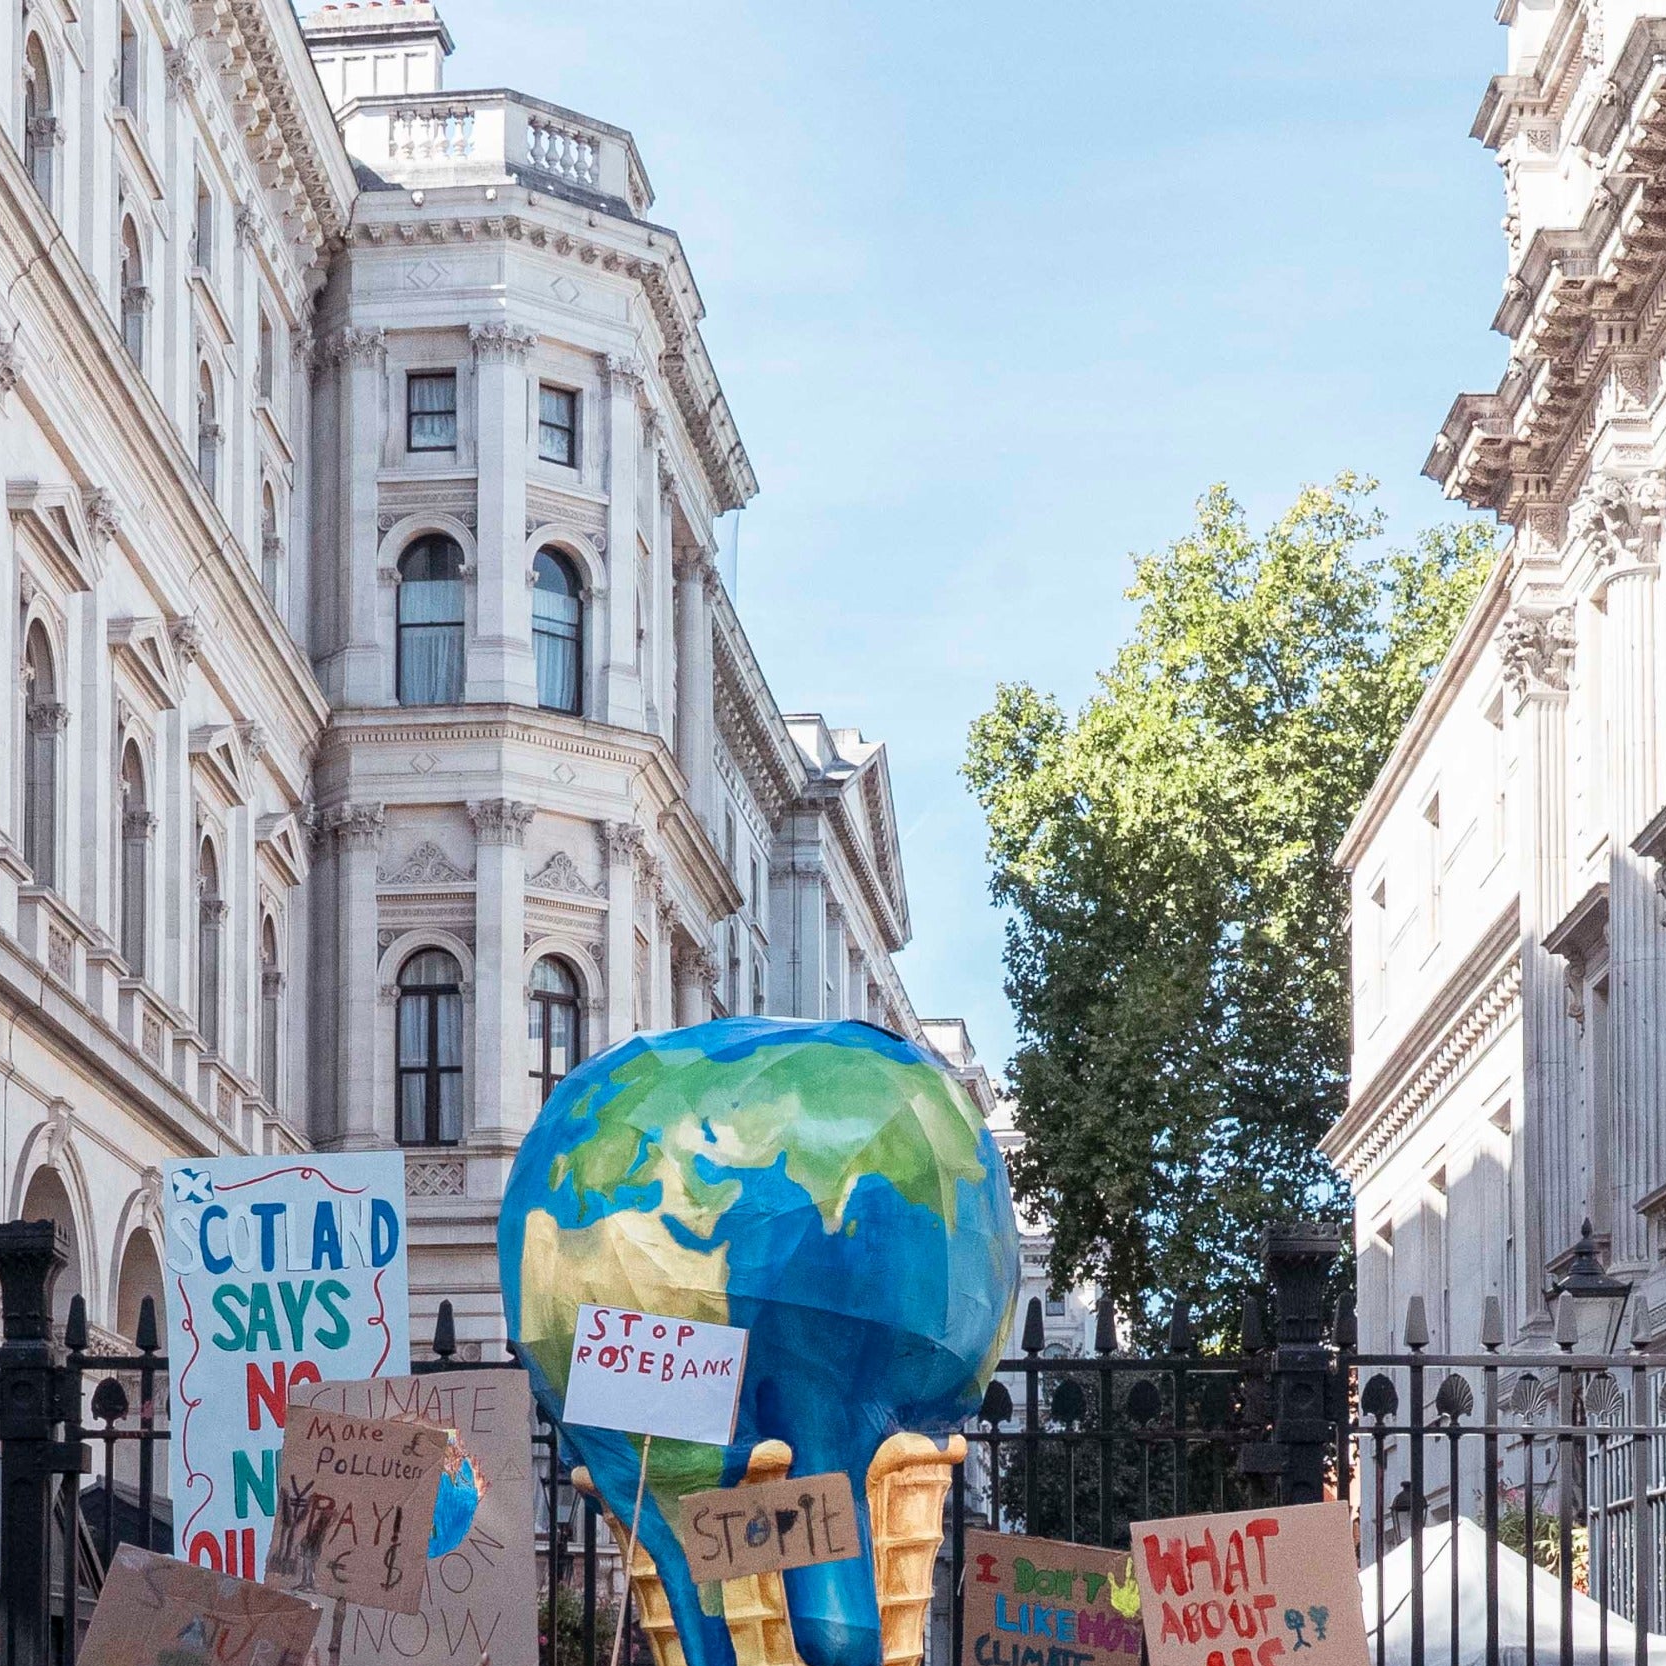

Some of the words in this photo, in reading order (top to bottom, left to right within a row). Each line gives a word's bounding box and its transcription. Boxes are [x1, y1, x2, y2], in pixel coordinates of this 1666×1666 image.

[165, 1196, 400, 1276] SCOTLAND
[210, 1278, 352, 1353] SAYS
[586, 1308, 695, 1348] STOP
[575, 1343, 735, 1383] ROSEBANK
[974, 1552, 1001, 1586] I
[1141, 1517, 1281, 1598] WHAT
[353, 1607, 502, 1658] NOW
[993, 1590, 1077, 1644] LIKE
[1160, 1593, 1278, 1646] ABOUT
